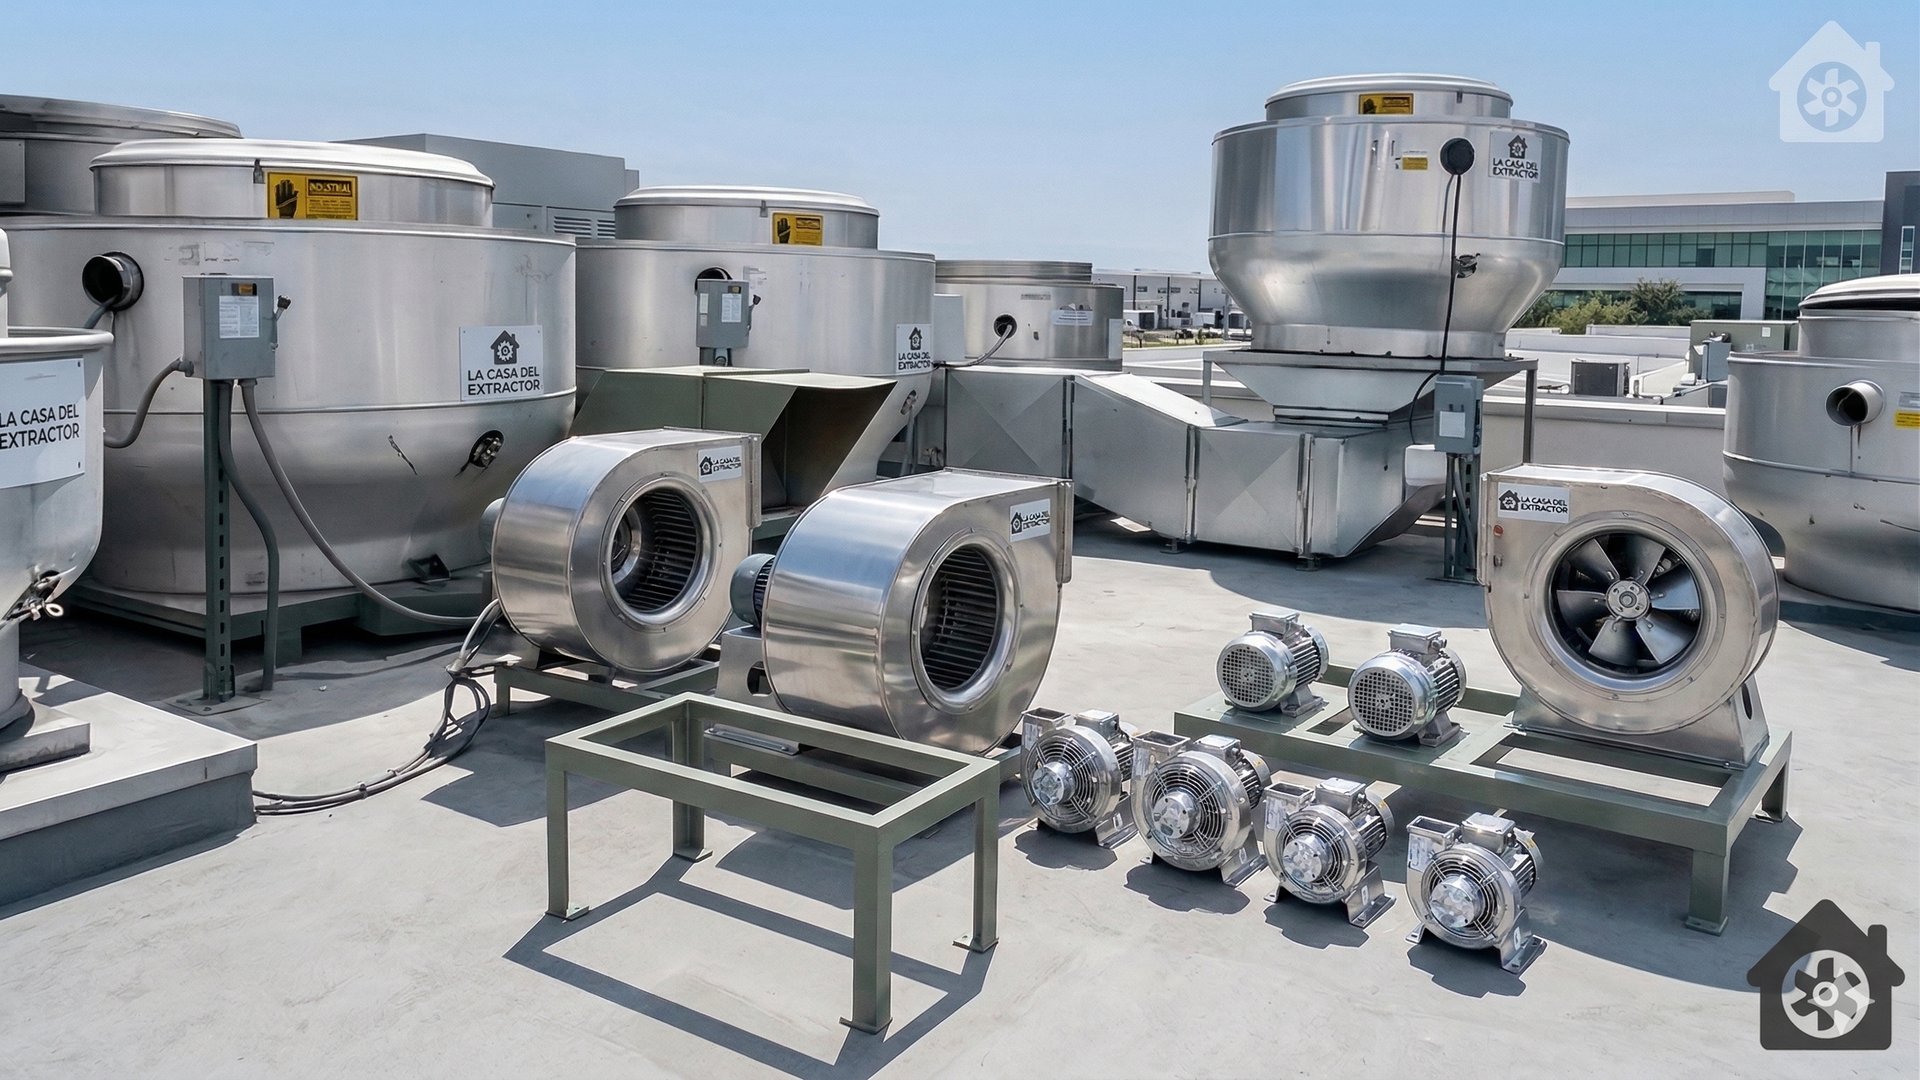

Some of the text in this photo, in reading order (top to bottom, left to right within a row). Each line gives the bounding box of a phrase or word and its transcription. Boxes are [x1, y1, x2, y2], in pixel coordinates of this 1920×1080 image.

[1493, 157, 1503, 166] LA
[468, 366, 540, 381] LA CASA DEL
[468, 379, 540, 396] EXTRACTOR
[0, 403, 79, 428] LA CASA DEL
[0, 422, 80, 449] EXTRACTOR
[1521, 503, 1568, 514] EXTRACTOR
[1532, 497, 1551, 505] CASA
[1553, 499, 1568, 507] DEL
